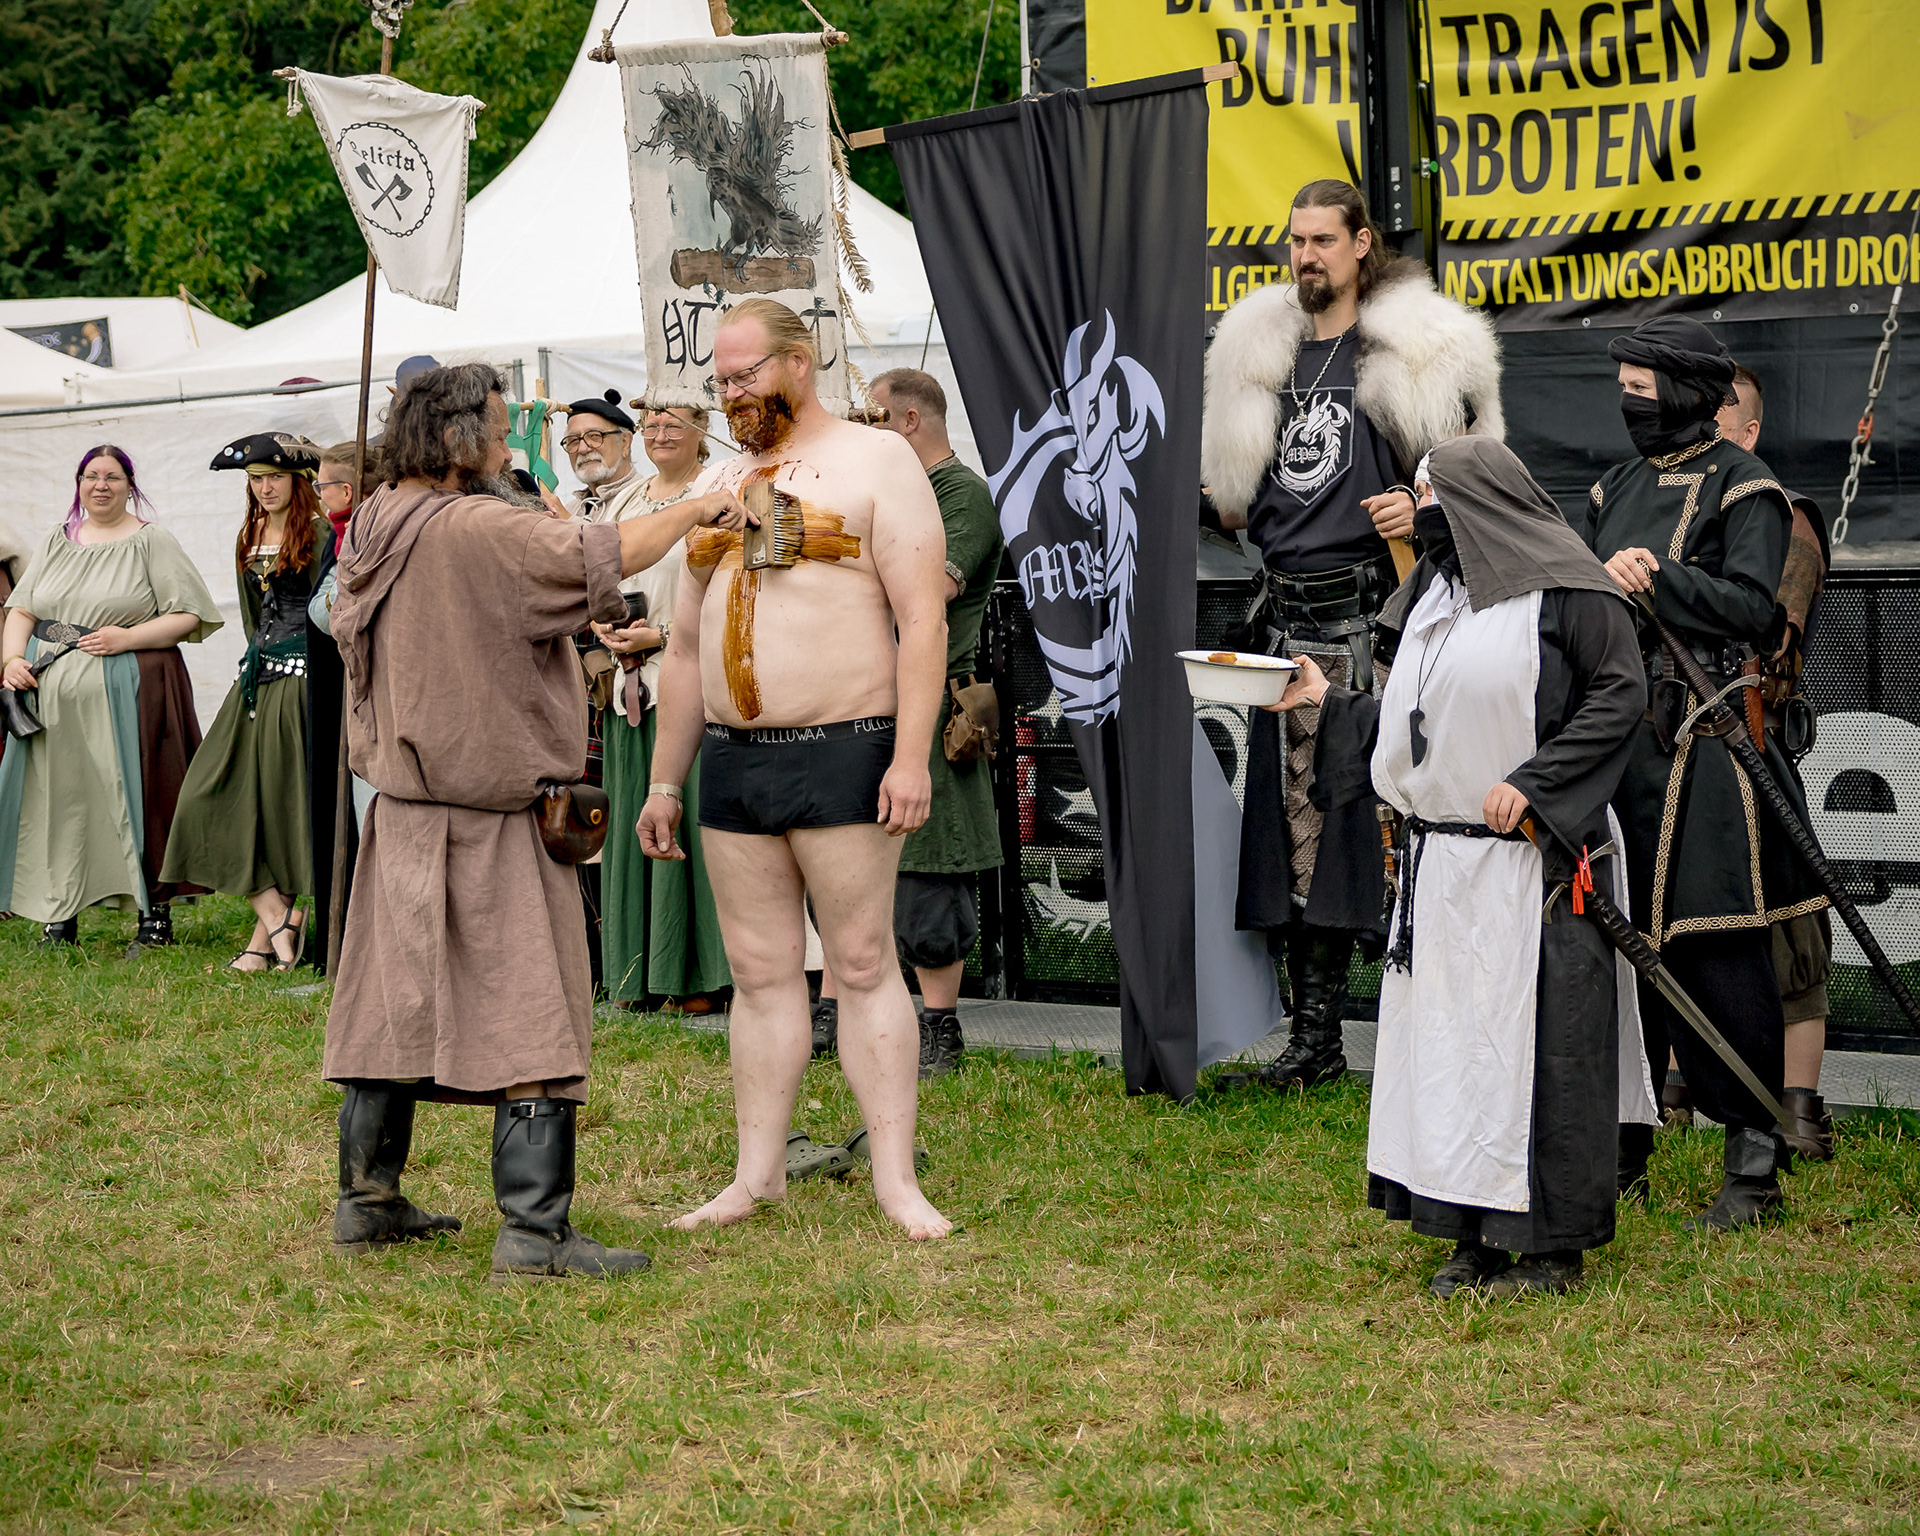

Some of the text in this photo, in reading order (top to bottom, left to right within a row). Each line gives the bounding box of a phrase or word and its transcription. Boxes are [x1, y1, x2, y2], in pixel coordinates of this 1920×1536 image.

[1440, 0, 1710, 96] TRAGEN
[349, 140, 415, 171] elicta
[1440, 239, 1826, 306] NSTALTUNGSABBRUCH
[1284, 446, 1321, 465] MPS
[750, 726, 826, 743] FULLLUWAA
